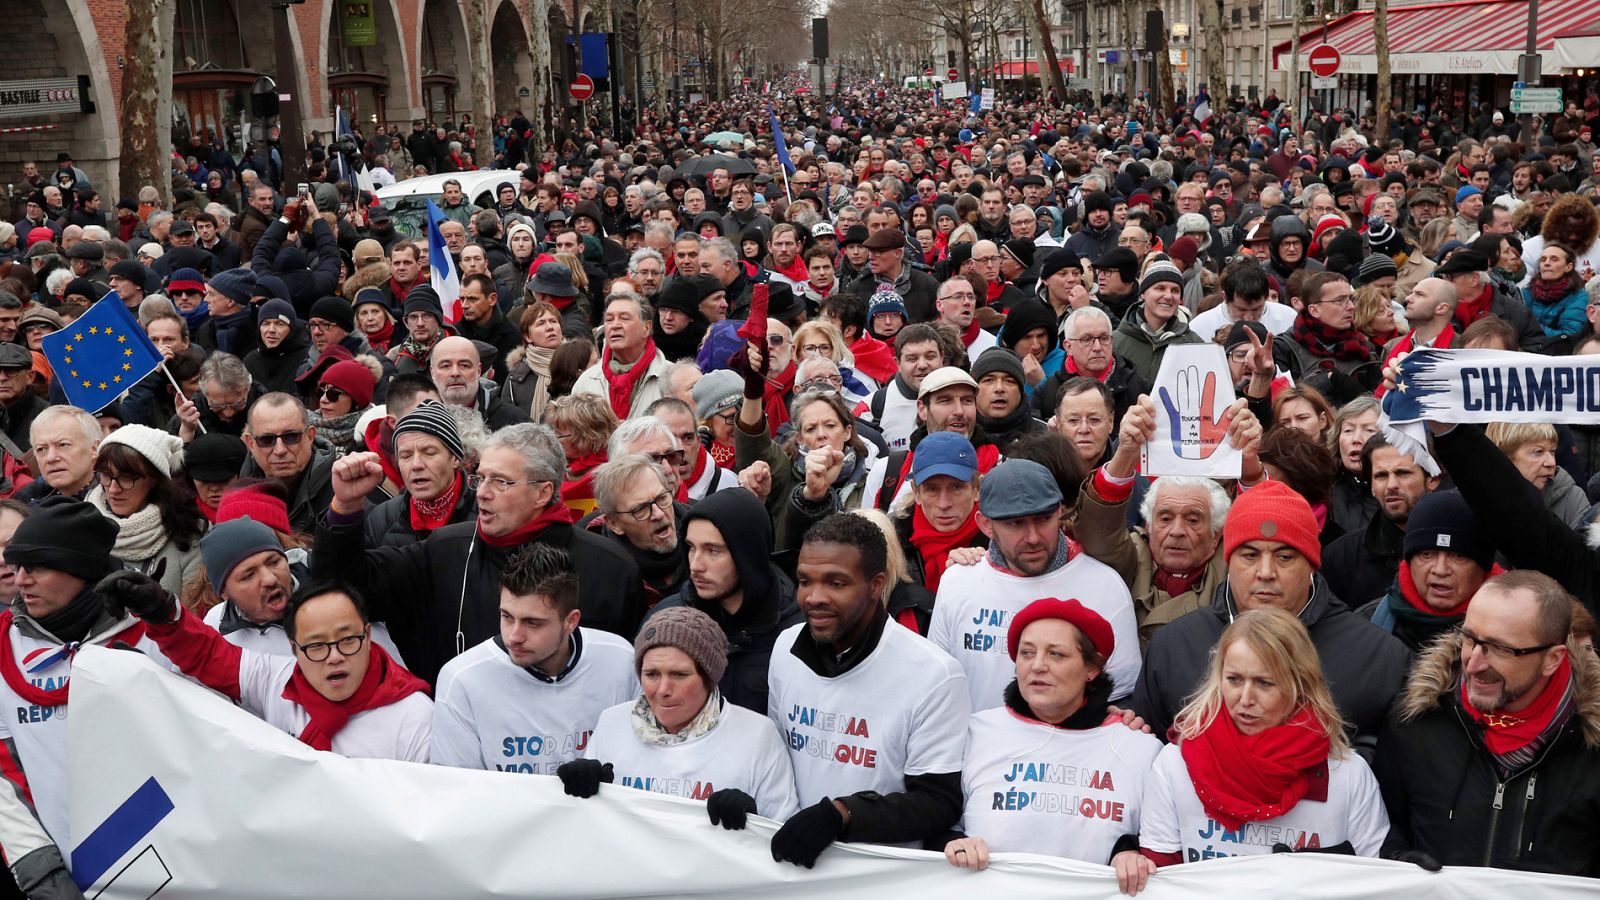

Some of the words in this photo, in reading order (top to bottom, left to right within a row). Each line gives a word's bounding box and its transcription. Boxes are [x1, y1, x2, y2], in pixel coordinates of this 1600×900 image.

[1, 89, 40, 105] BASTILLE
[1460, 367, 1600, 412] CHAMPIO
[788, 704, 836, 732] J'AIME
[837, 714, 869, 738] MA
[503, 736, 557, 757] STOP
[683, 779, 714, 800] MA
[1004, 763, 1078, 786] J'AIME
[1080, 767, 1115, 791] MA
[992, 786, 1125, 822] RÉPUBLIQUE
